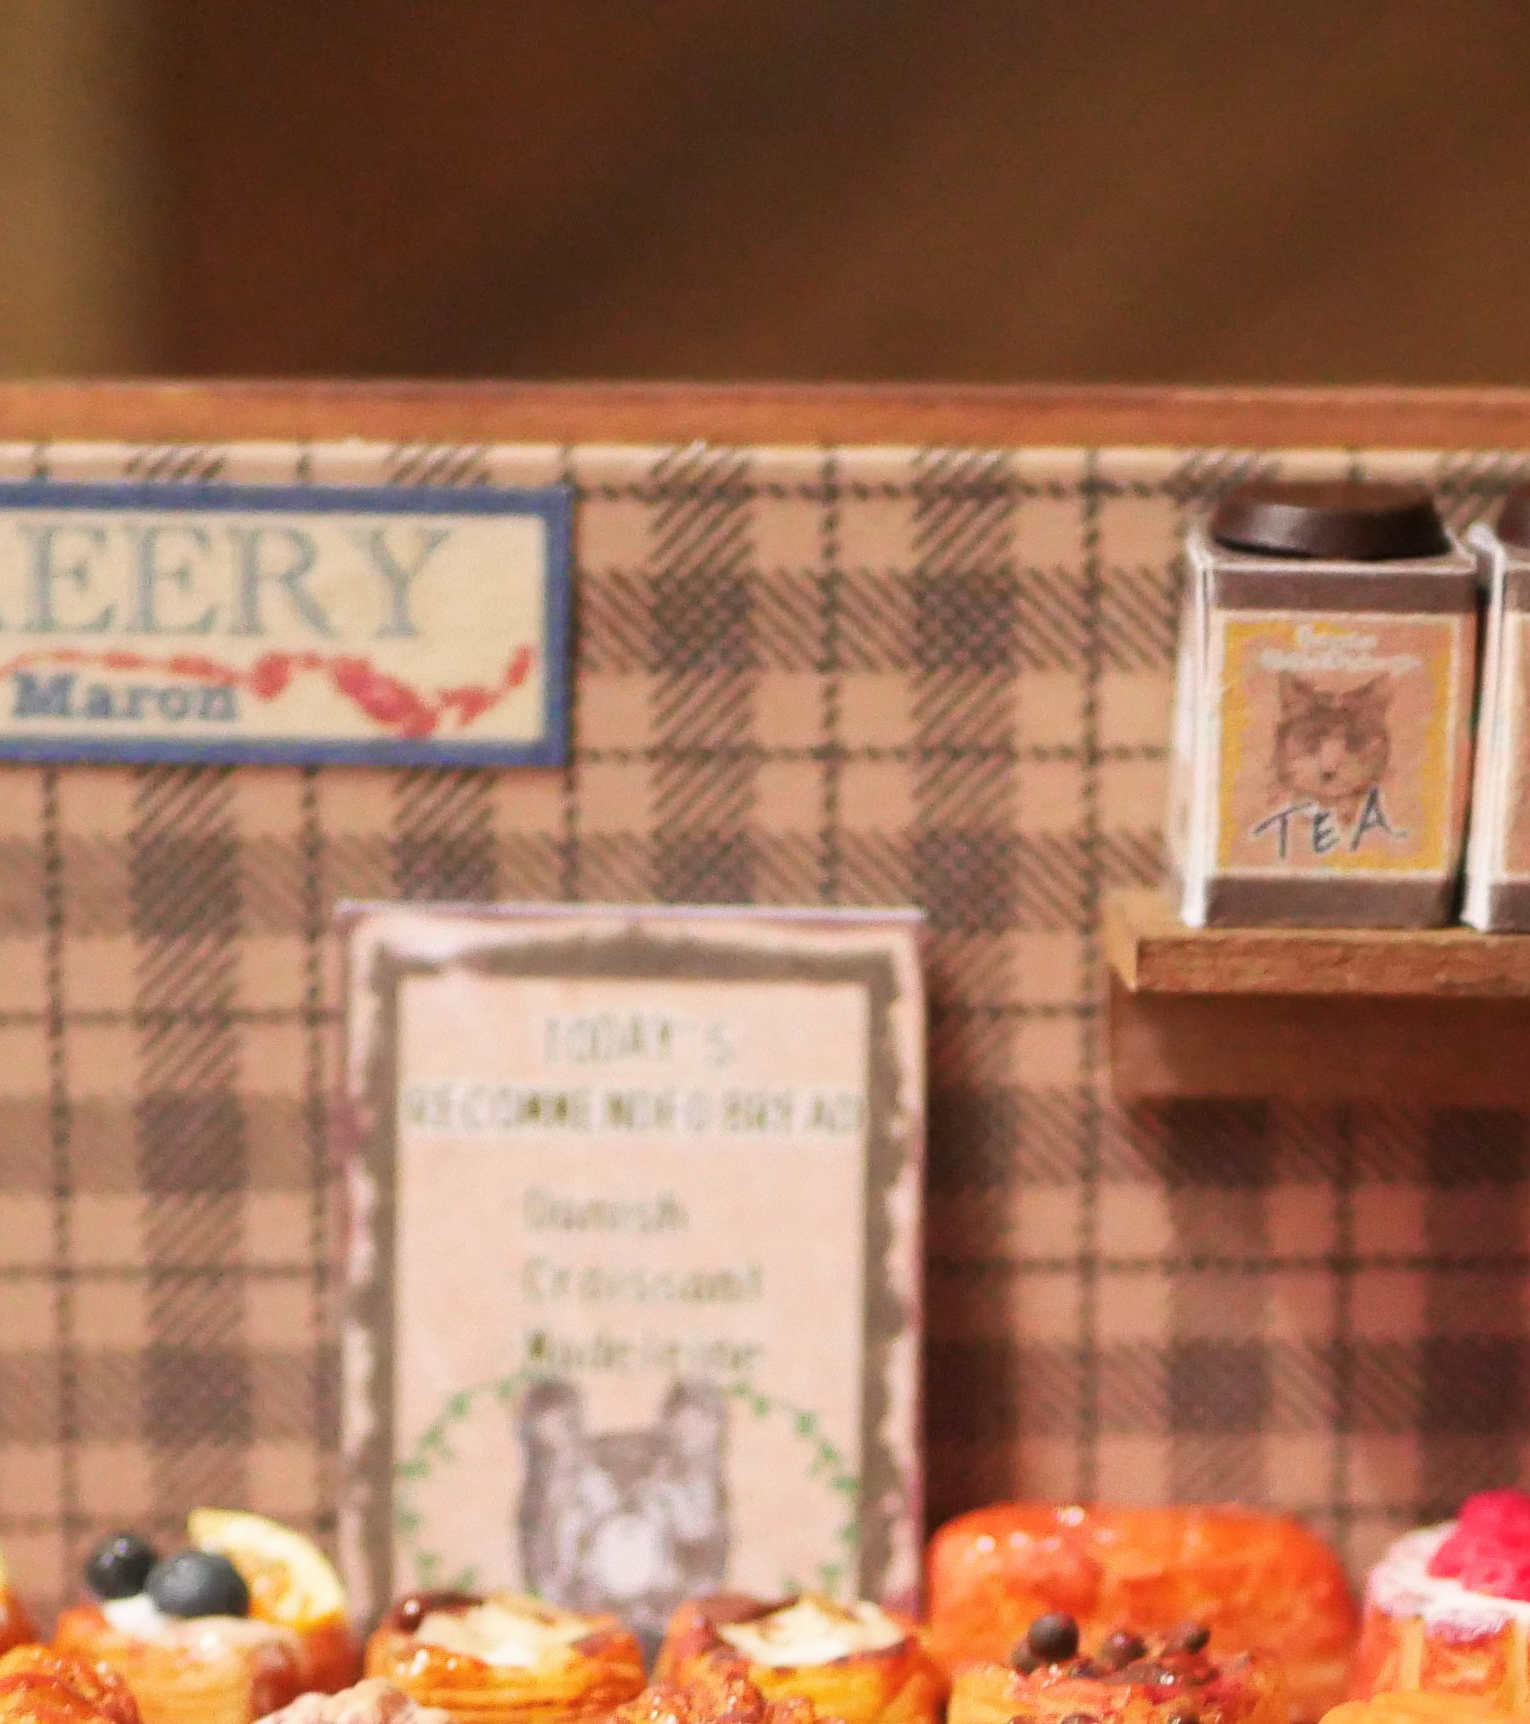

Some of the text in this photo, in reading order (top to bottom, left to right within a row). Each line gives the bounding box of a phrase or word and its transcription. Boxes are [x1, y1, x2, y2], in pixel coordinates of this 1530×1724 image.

[9, 671, 239, 725] Maron
[1252, 787, 1409, 860] TEA
[521, 1257, 765, 1303] Croissant
